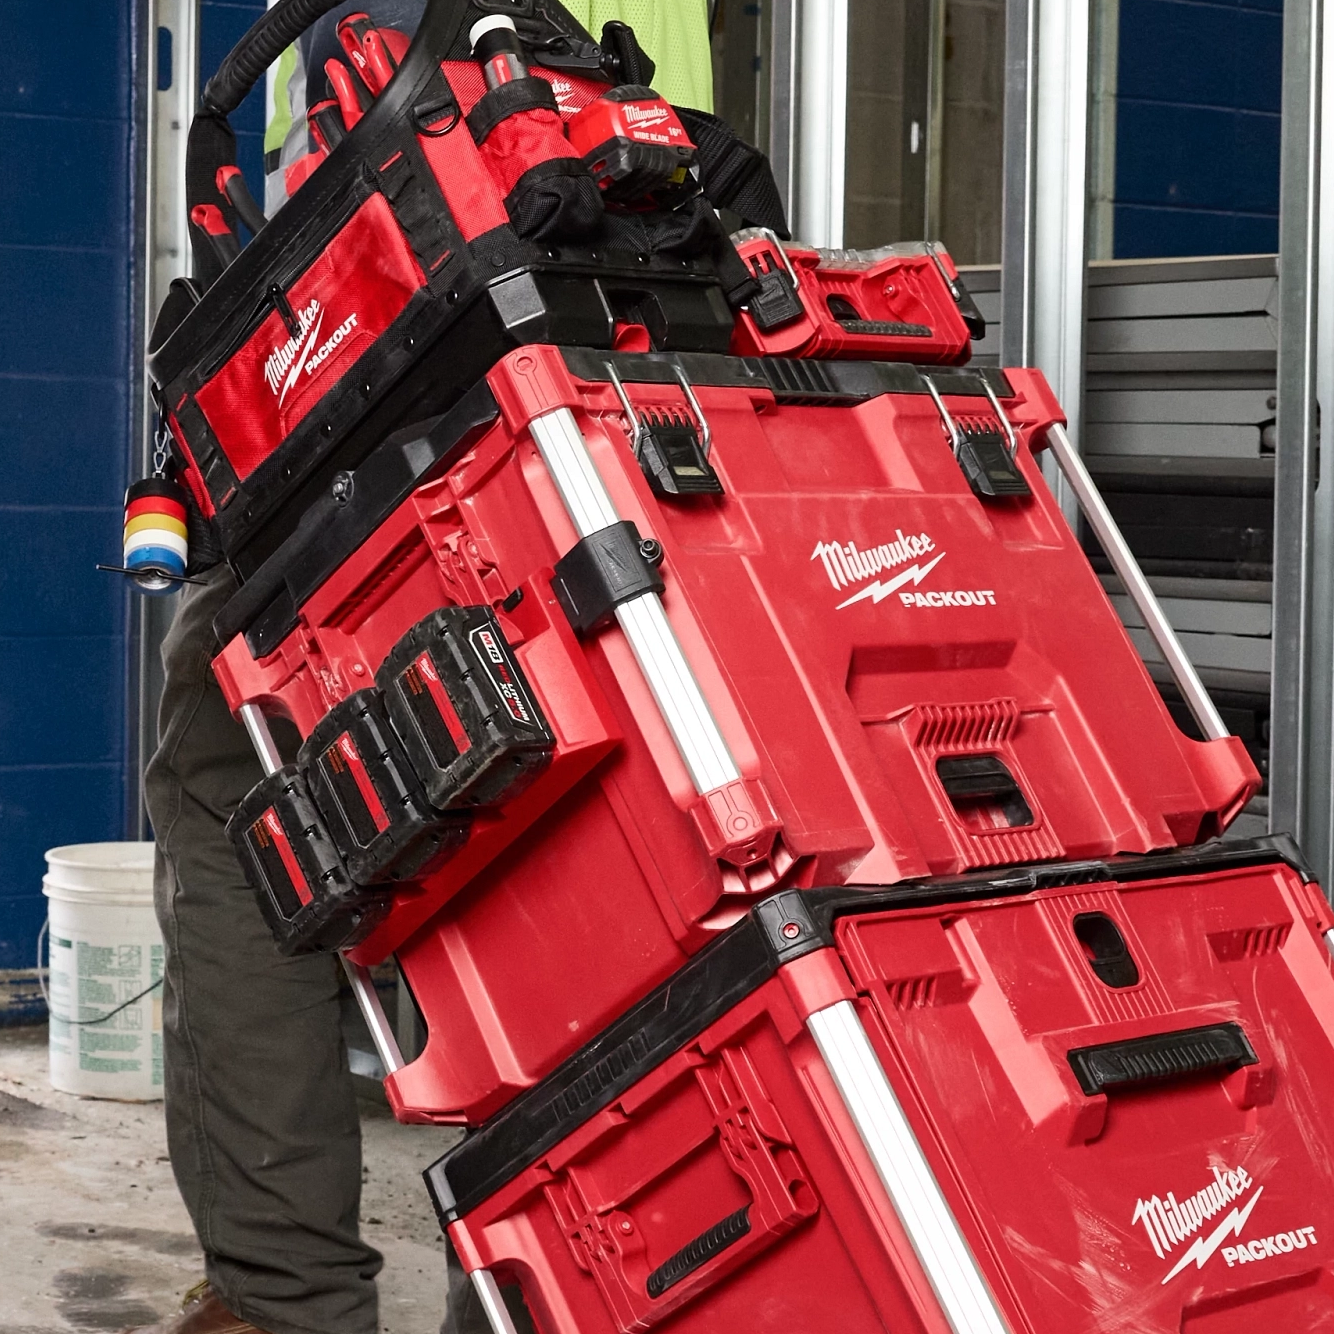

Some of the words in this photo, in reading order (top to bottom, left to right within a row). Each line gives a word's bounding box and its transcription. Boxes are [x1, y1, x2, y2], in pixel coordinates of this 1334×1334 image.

[621, 104, 669, 123] Milwaukee
[633, 131, 650, 140] WIDE
[650, 133, 670, 143] BLADE
[304, 313, 358, 375] PACKOUT
[810, 530, 936, 591] Milwaukee
[899, 589, 997, 608] PACKOUT
[482, 633, 500, 660] M18
[1131, 1165, 1253, 1260] Milwaukee
[1221, 1225, 1318, 1268] PACKOUT
